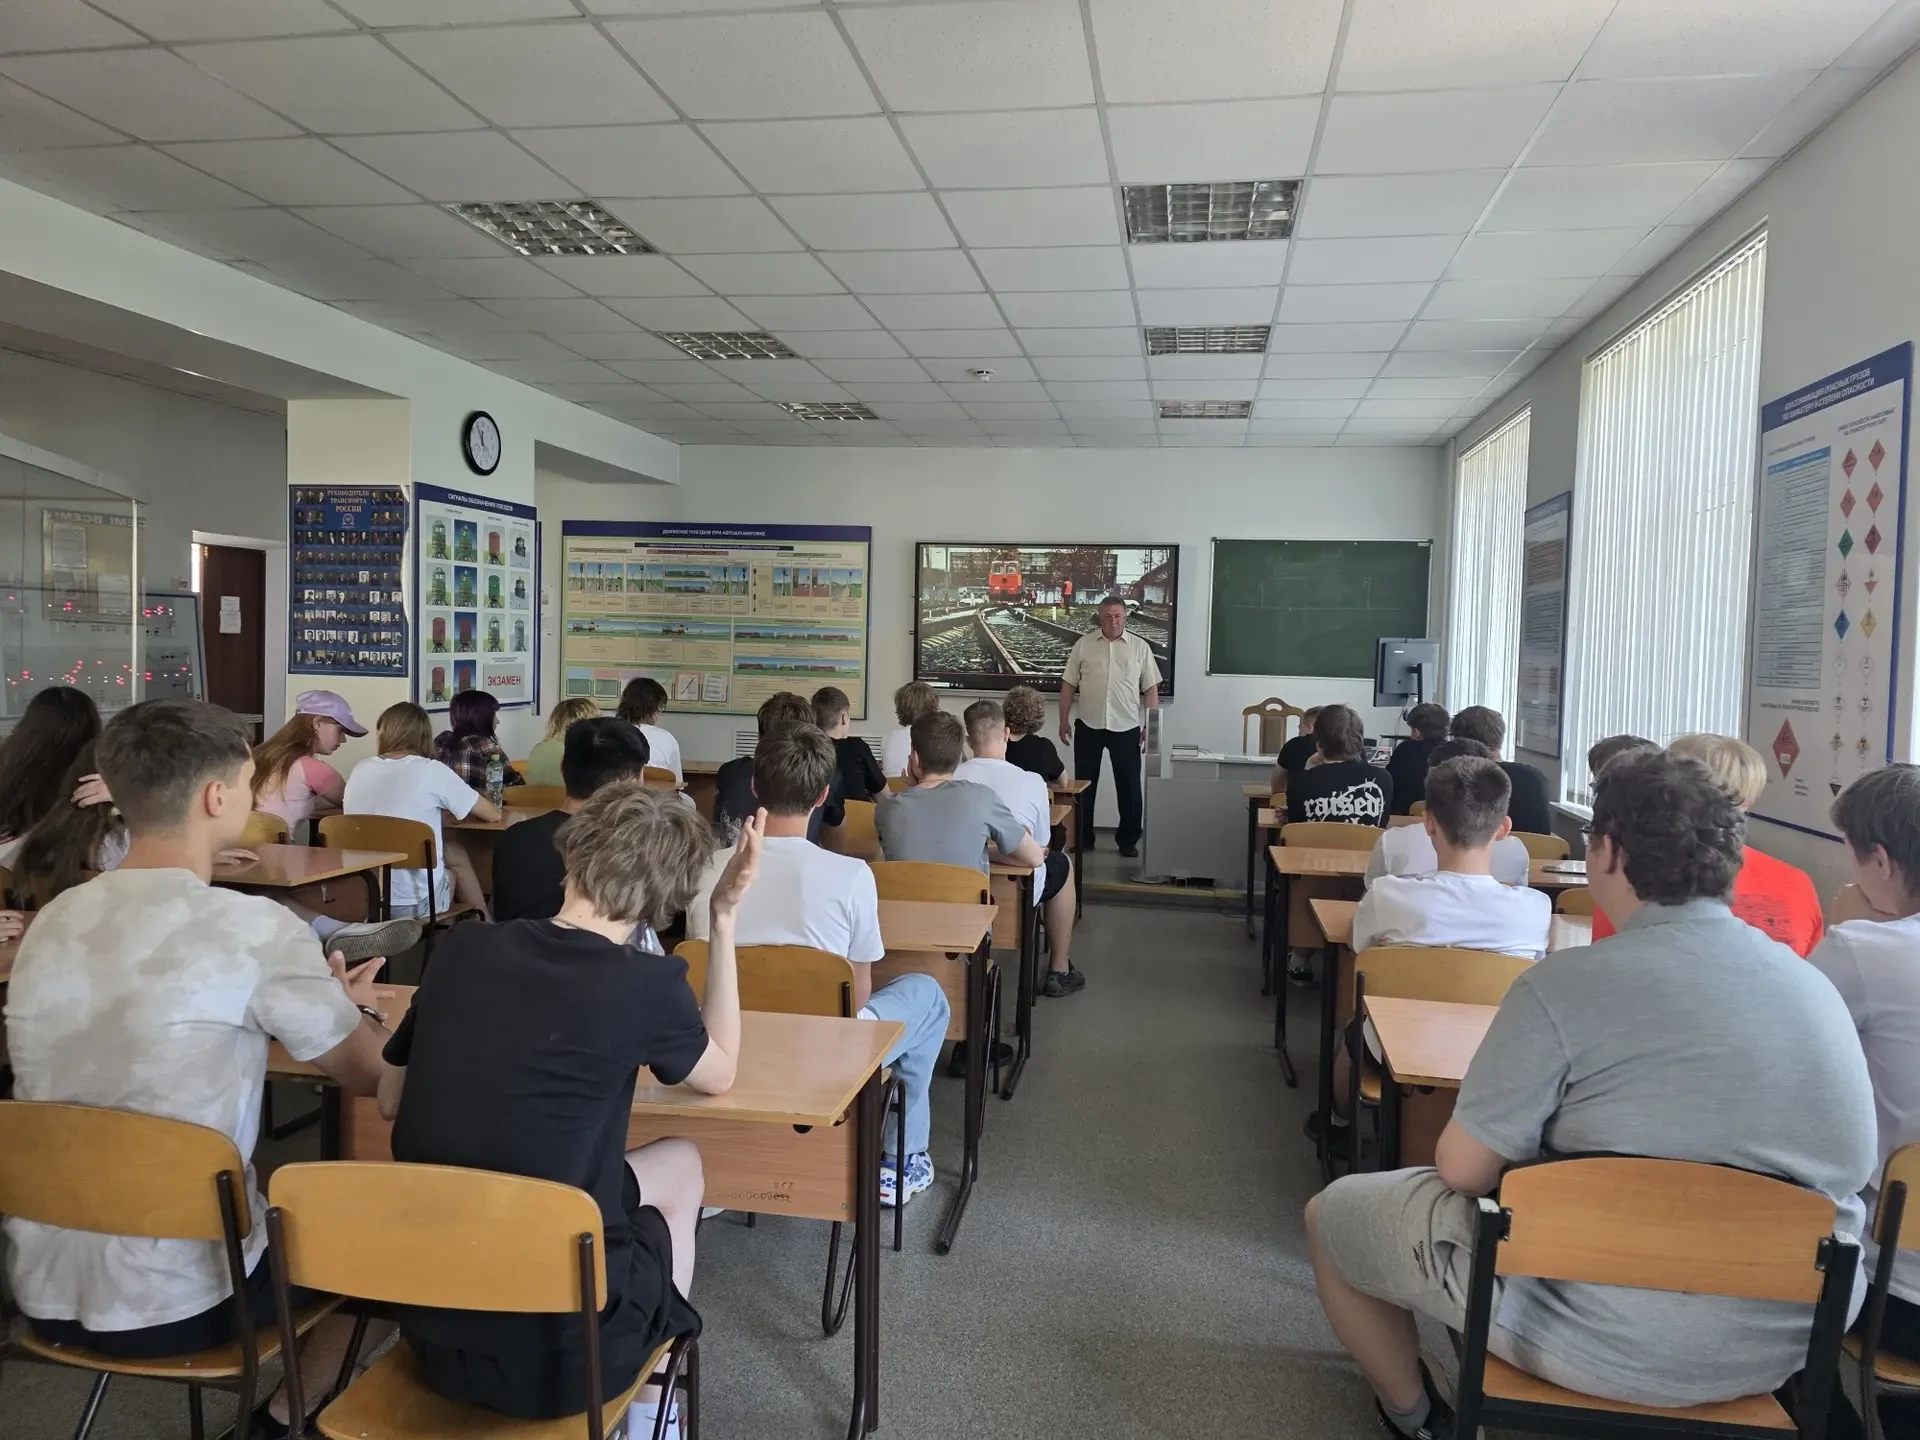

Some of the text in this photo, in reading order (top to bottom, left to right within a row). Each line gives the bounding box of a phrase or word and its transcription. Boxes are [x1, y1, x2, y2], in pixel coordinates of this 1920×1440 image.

[1849, 368, 1871, 384] ГРУЗОВ
[1841, 377, 1875, 397] ОПАСНОСТИ
[488, 675, 521, 687] ЭКЗАМЕН
[1304, 791, 1381, 817] raised
